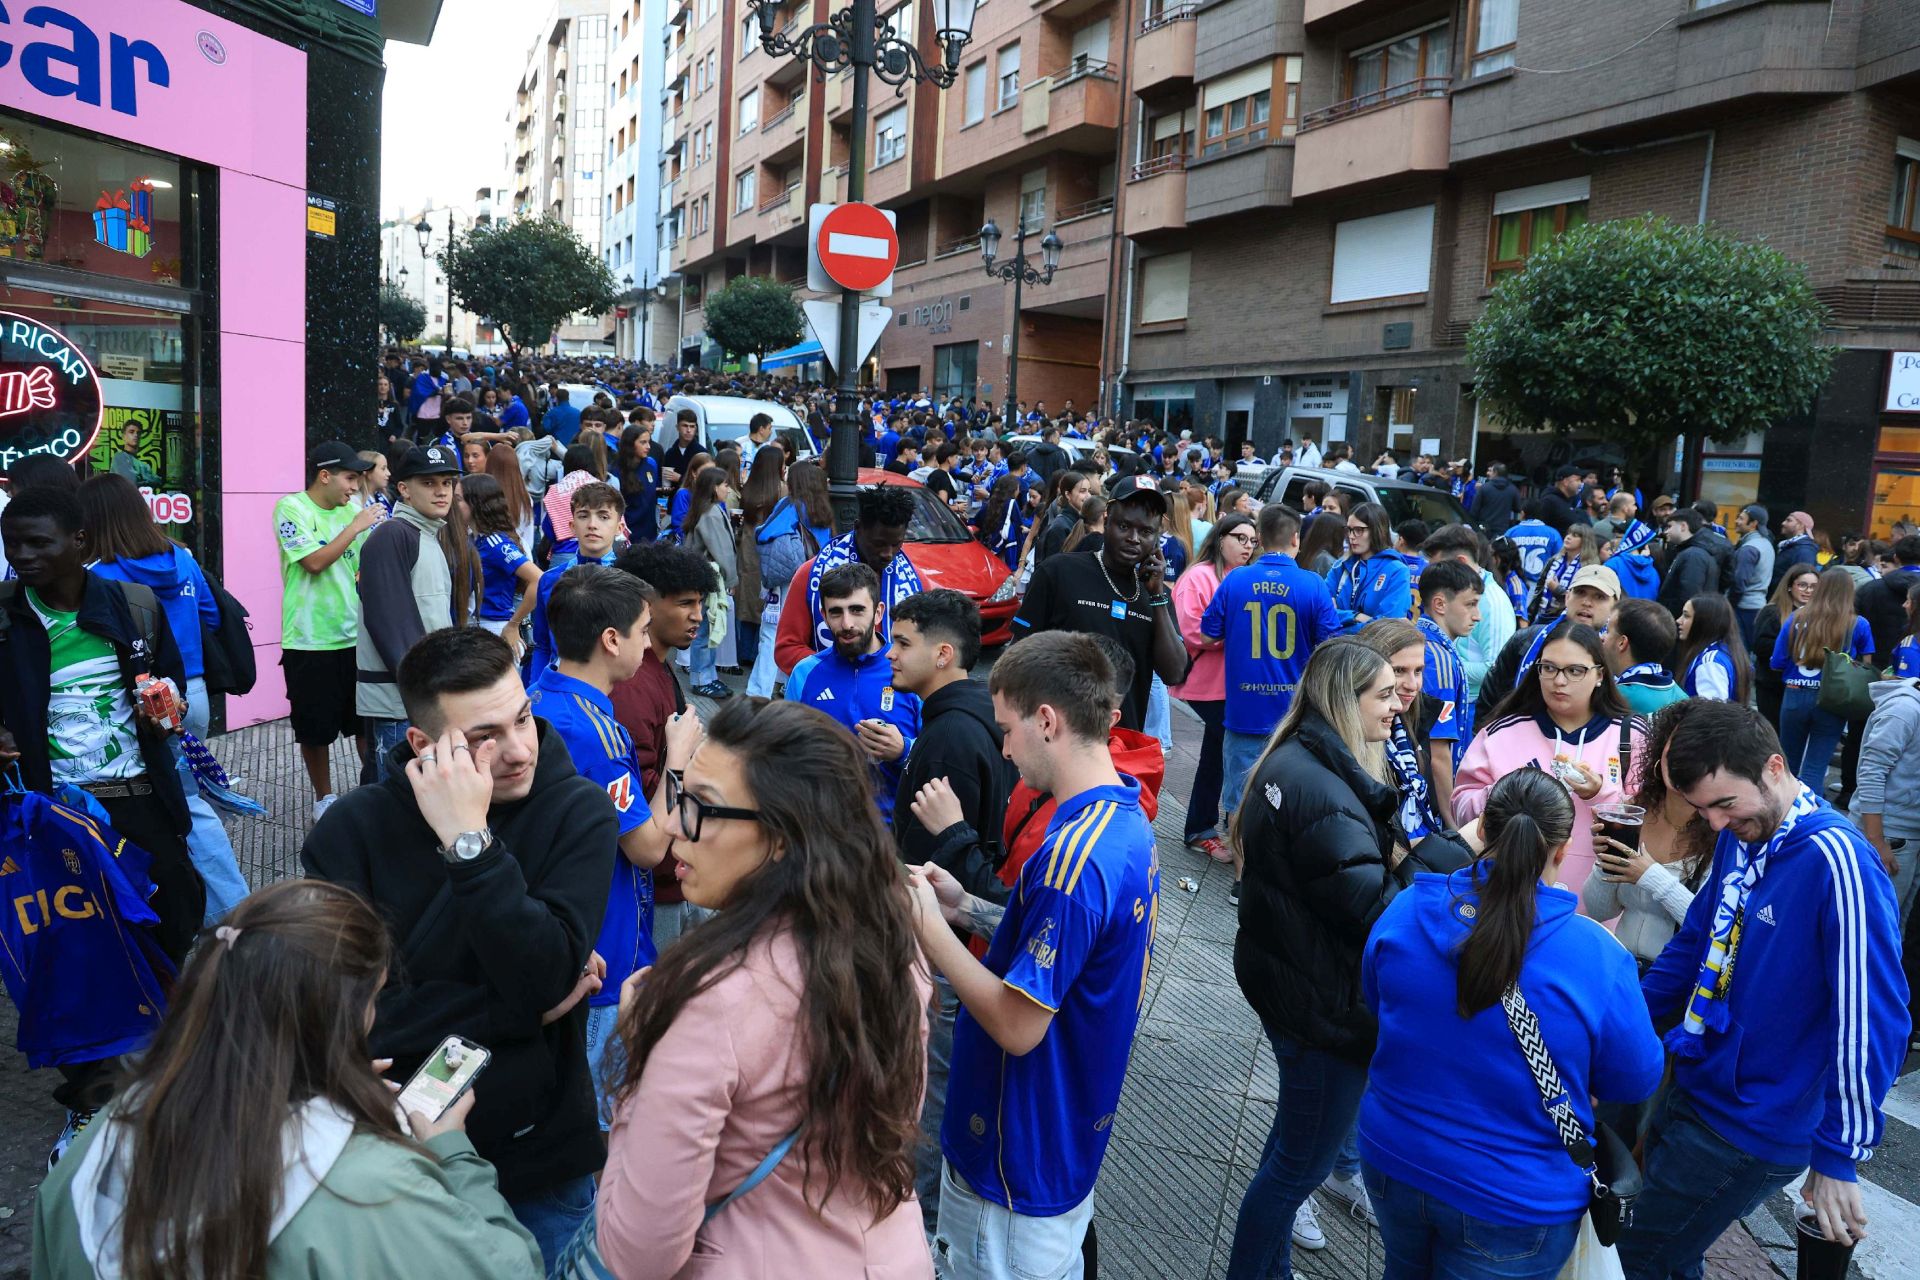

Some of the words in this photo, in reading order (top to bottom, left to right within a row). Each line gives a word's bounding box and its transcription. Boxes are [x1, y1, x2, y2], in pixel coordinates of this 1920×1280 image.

[913, 296, 952, 326] nerón
[11, 321, 87, 385] RICAR
[1252, 581, 1290, 598] PRESI
[1077, 599, 1096, 607] NEVER
[1096, 602, 1110, 610] STOP
[1243, 601, 1296, 660] 10
[1794, 678, 1820, 687] HYUN
[1756, 912, 1776, 927] adidas
